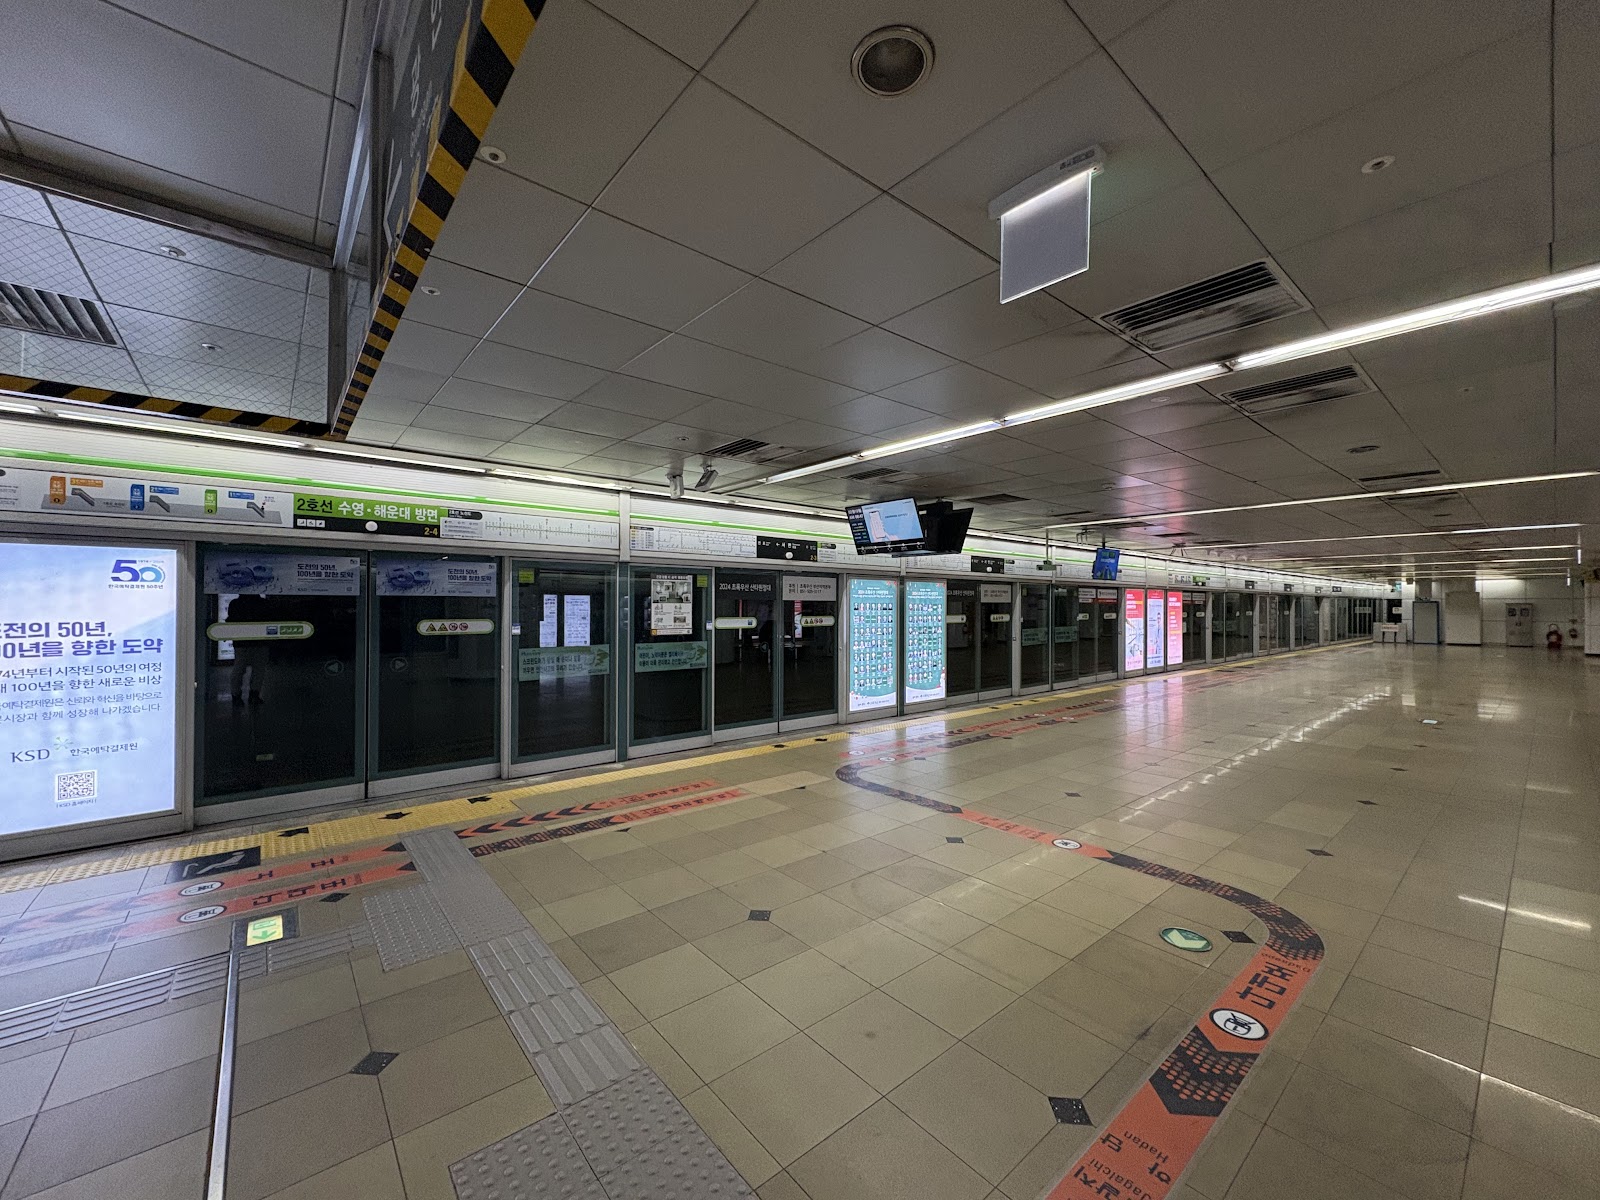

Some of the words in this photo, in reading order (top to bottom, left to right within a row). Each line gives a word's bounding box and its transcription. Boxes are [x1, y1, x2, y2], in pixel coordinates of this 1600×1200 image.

[296, 498, 333, 514] 2호선
[415, 508, 438, 522] 방면
[424, 527, 438, 536] 2-4
[719, 582, 731, 590] 2024
[58, 621, 112, 638] 50년,
[0, 641, 64, 659] 0년을
[71, 640, 117, 656] 향한
[122, 638, 164, 654] 도약
[56, 665, 94, 676] 시작된
[96, 663, 136, 674] 50년의
[138, 662, 162, 672] 여정
[12, 680, 65, 692] 100년을
[68, 678, 96, 690] 향한
[98, 677, 136, 688] 새로운
[138, 674, 162, 686] 비상
[0, 698, 64, 711] 예탁결제원은
[126, 692, 163, 701] 바탕으로
[42, 710, 64, 720] 함께
[66, 708, 99, 719] 성장해
[10, 749, 50, 763] KSD
[70, 742, 138, 756] 한국예탁결제원
[1236, 961, 1298, 1010] 다대포
[1124, 1131, 1168, 1164] Hadan
[1074, 1166, 1132, 1200] 갈치
